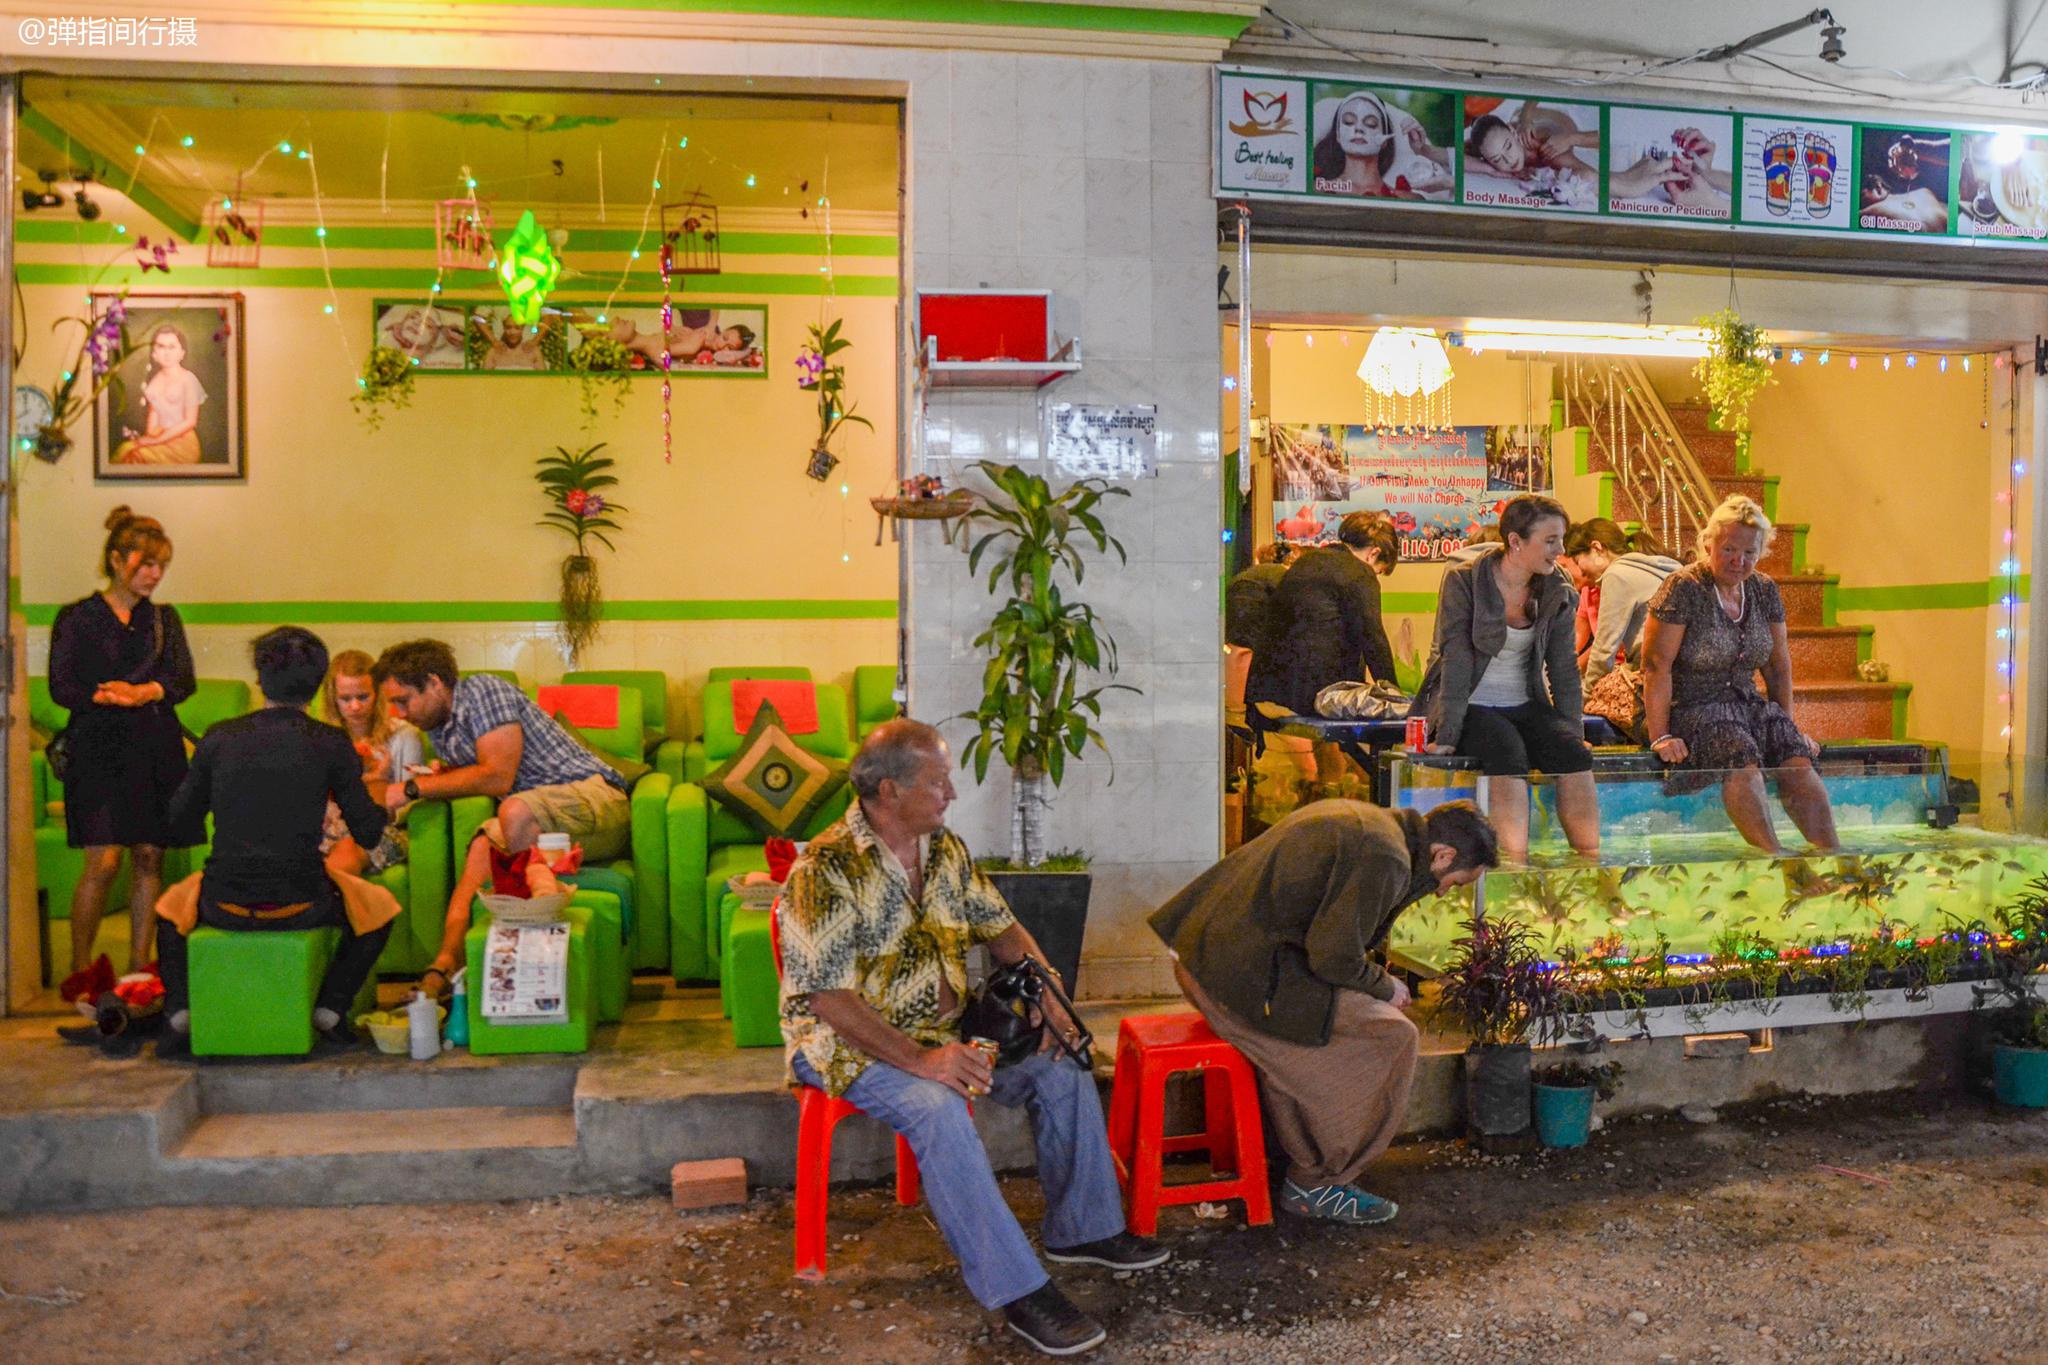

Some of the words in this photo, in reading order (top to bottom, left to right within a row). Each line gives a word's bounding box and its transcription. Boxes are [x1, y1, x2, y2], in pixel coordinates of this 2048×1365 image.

[1316, 177, 1353, 192] Facial
[1466, 191, 1495, 204] Body
[1498, 193, 1547, 208] Massage
[1611, 199, 1660, 214] Manicure
[1662, 204, 1673, 214] or
[1676, 205, 1728, 218] Pecdicure
[1861, 215, 1876, 228] Oil
[1877, 216, 1922, 232] Massage
[1975, 222, 2002, 235] Scrub
[2004, 224, 2046, 239] Massage
[1407, 475, 1429, 488] Make
[1432, 475, 1449, 488] You
[1450, 475, 1486, 489] Unhappy
[1385, 492, 1398, 504] We
[1401, 493, 1415, 504] will
[1418, 493, 1433, 504] Not
[1435, 492, 1466, 506] Charge
